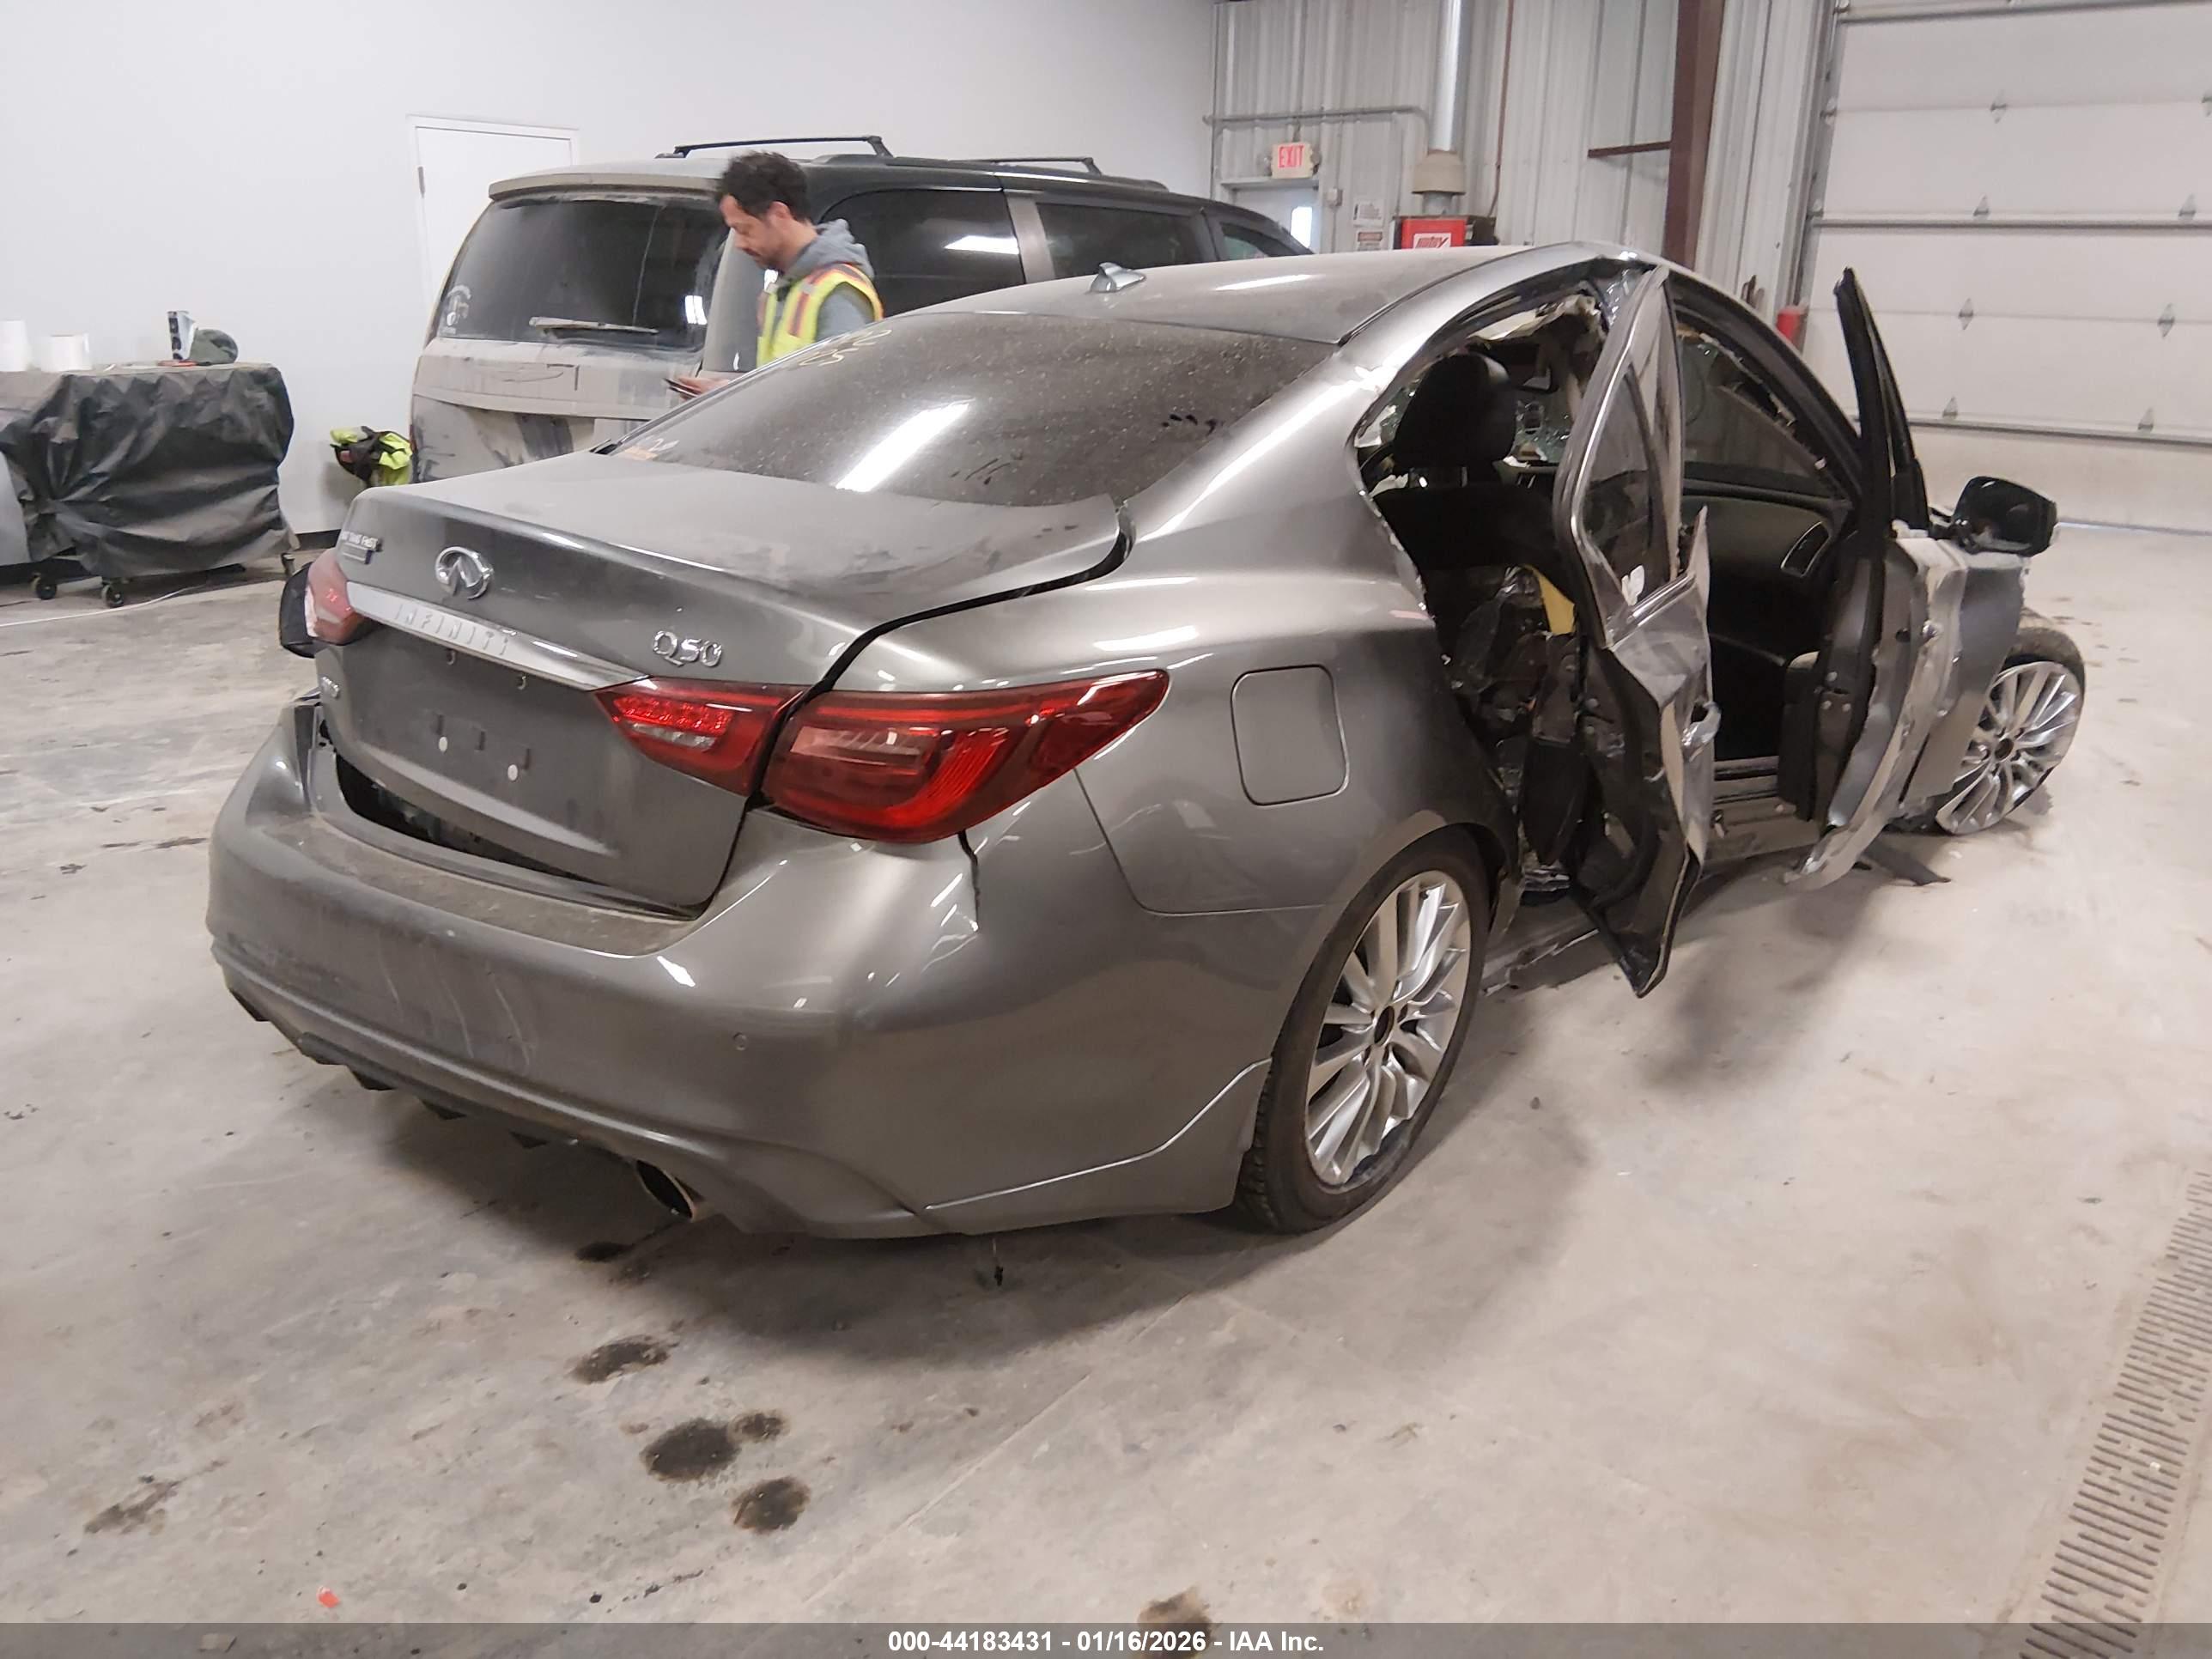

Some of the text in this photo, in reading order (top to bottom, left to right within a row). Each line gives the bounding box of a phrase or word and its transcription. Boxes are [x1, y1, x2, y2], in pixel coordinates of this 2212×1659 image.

[1278, 143, 1305, 168] EXIT
[394, 603, 510, 656] INFINITI
[653, 629, 723, 667] Q50
